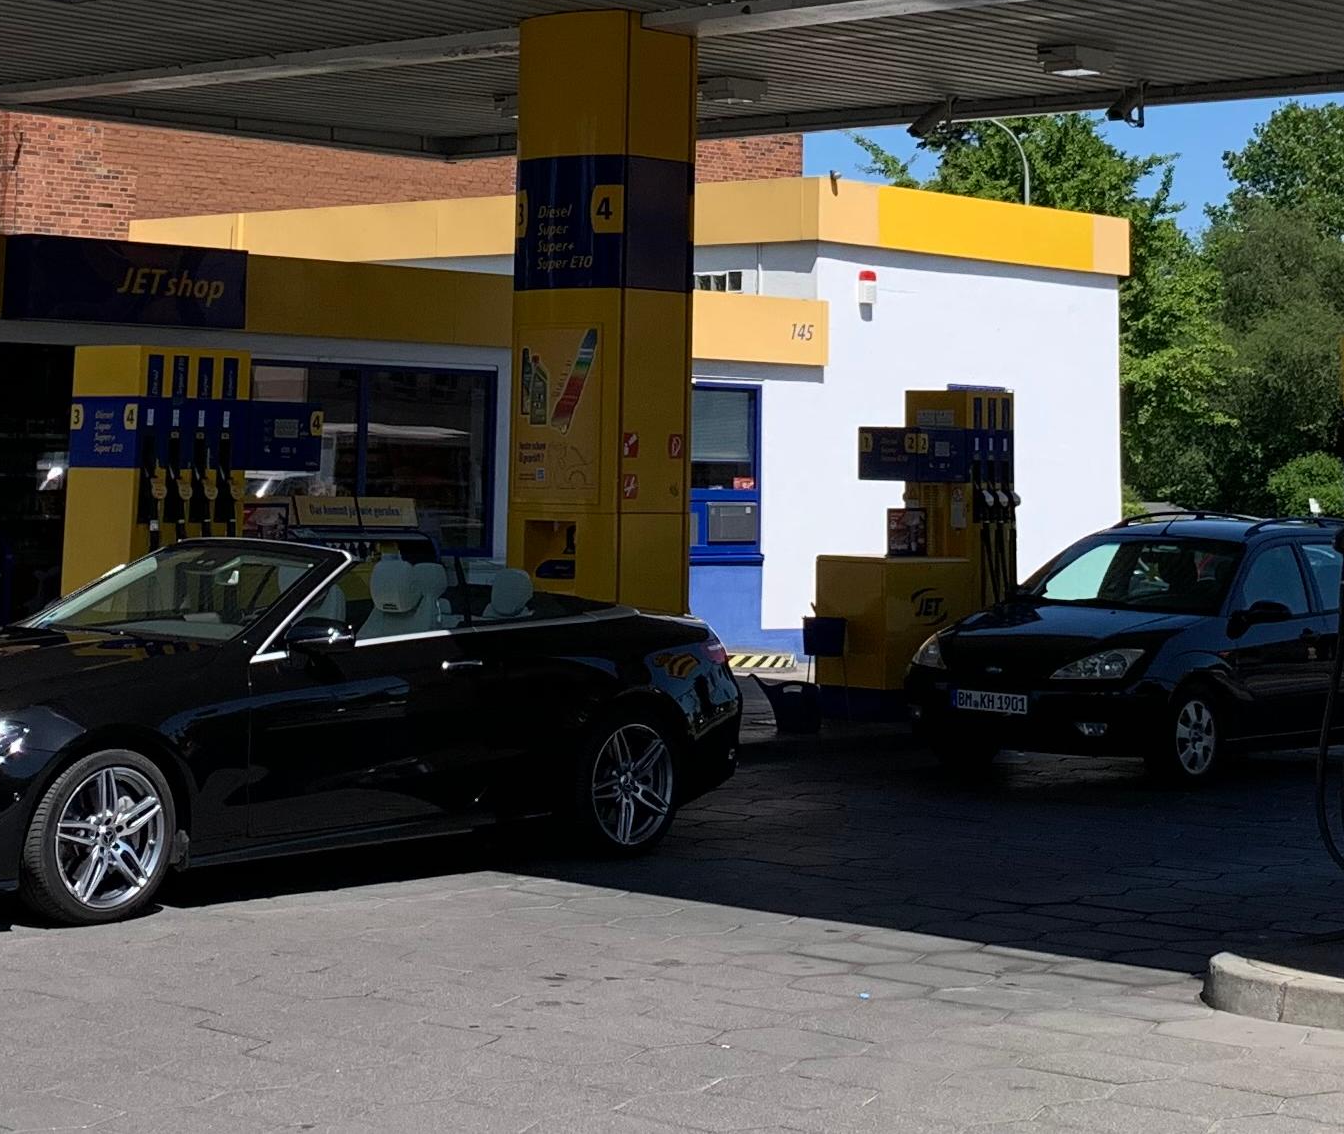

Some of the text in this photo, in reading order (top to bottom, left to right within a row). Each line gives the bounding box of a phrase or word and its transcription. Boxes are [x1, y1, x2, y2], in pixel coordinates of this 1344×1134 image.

[537, 203, 573, 218] Diesel
[596, 197, 613, 220] 4
[537, 223, 569, 238] Super
[537, 240, 575, 255] Super+
[537, 255, 593, 273] Super E10
[116, 267, 225, 307] JET shop
[791, 323, 814, 341] 145
[73, 409, 80, 424] 3
[126, 409, 134, 424] 4
[312, 415, 320, 429] 4
[915, 598, 944, 617] JET
[958, 692, 1025, 712] BM KH 1901
